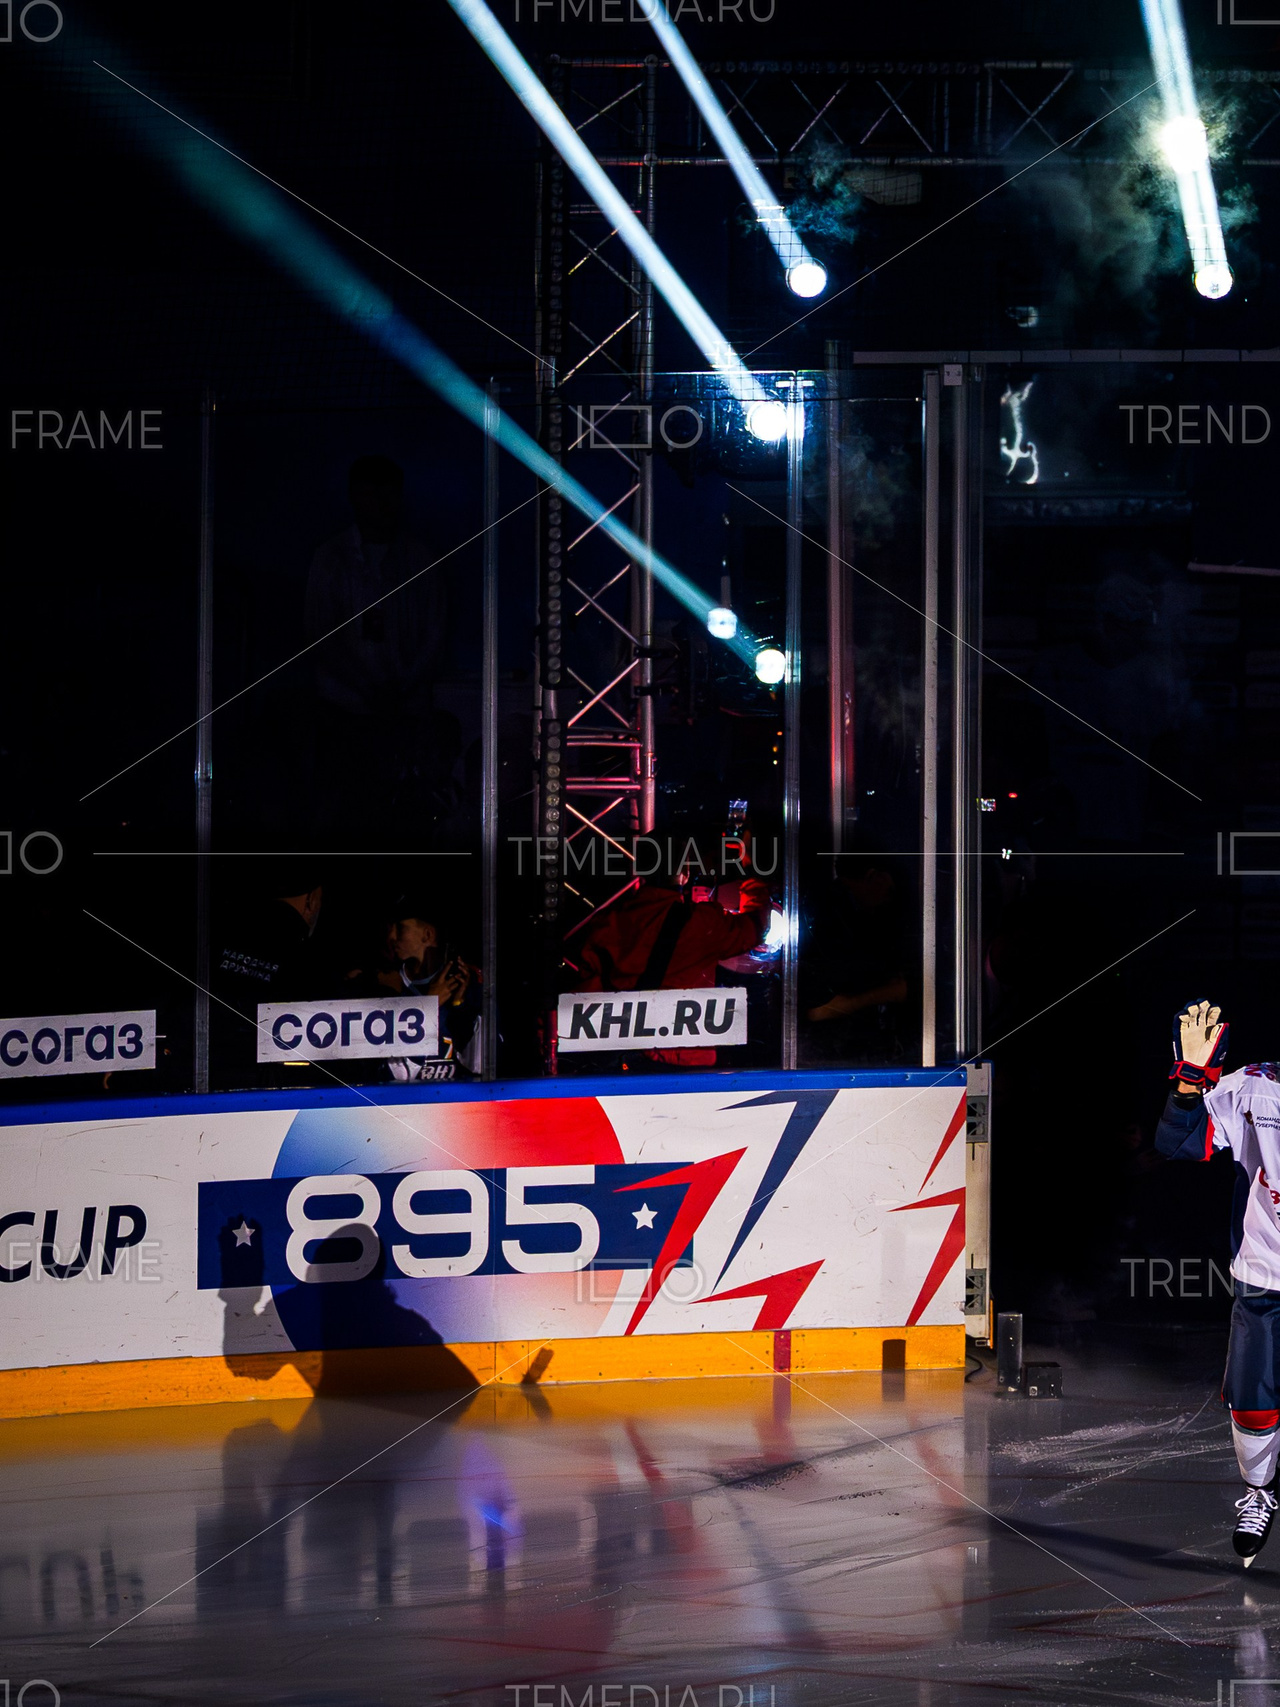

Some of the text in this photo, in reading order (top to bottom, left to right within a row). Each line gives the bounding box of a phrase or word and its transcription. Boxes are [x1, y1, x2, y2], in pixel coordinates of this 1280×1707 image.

[222, 948, 280, 972] НАРОДНАЯ
[570, 998, 736, 1040] KHL.RU
[0, 1204, 147, 1283] CUP
[285, 1165, 600, 1284] 895
